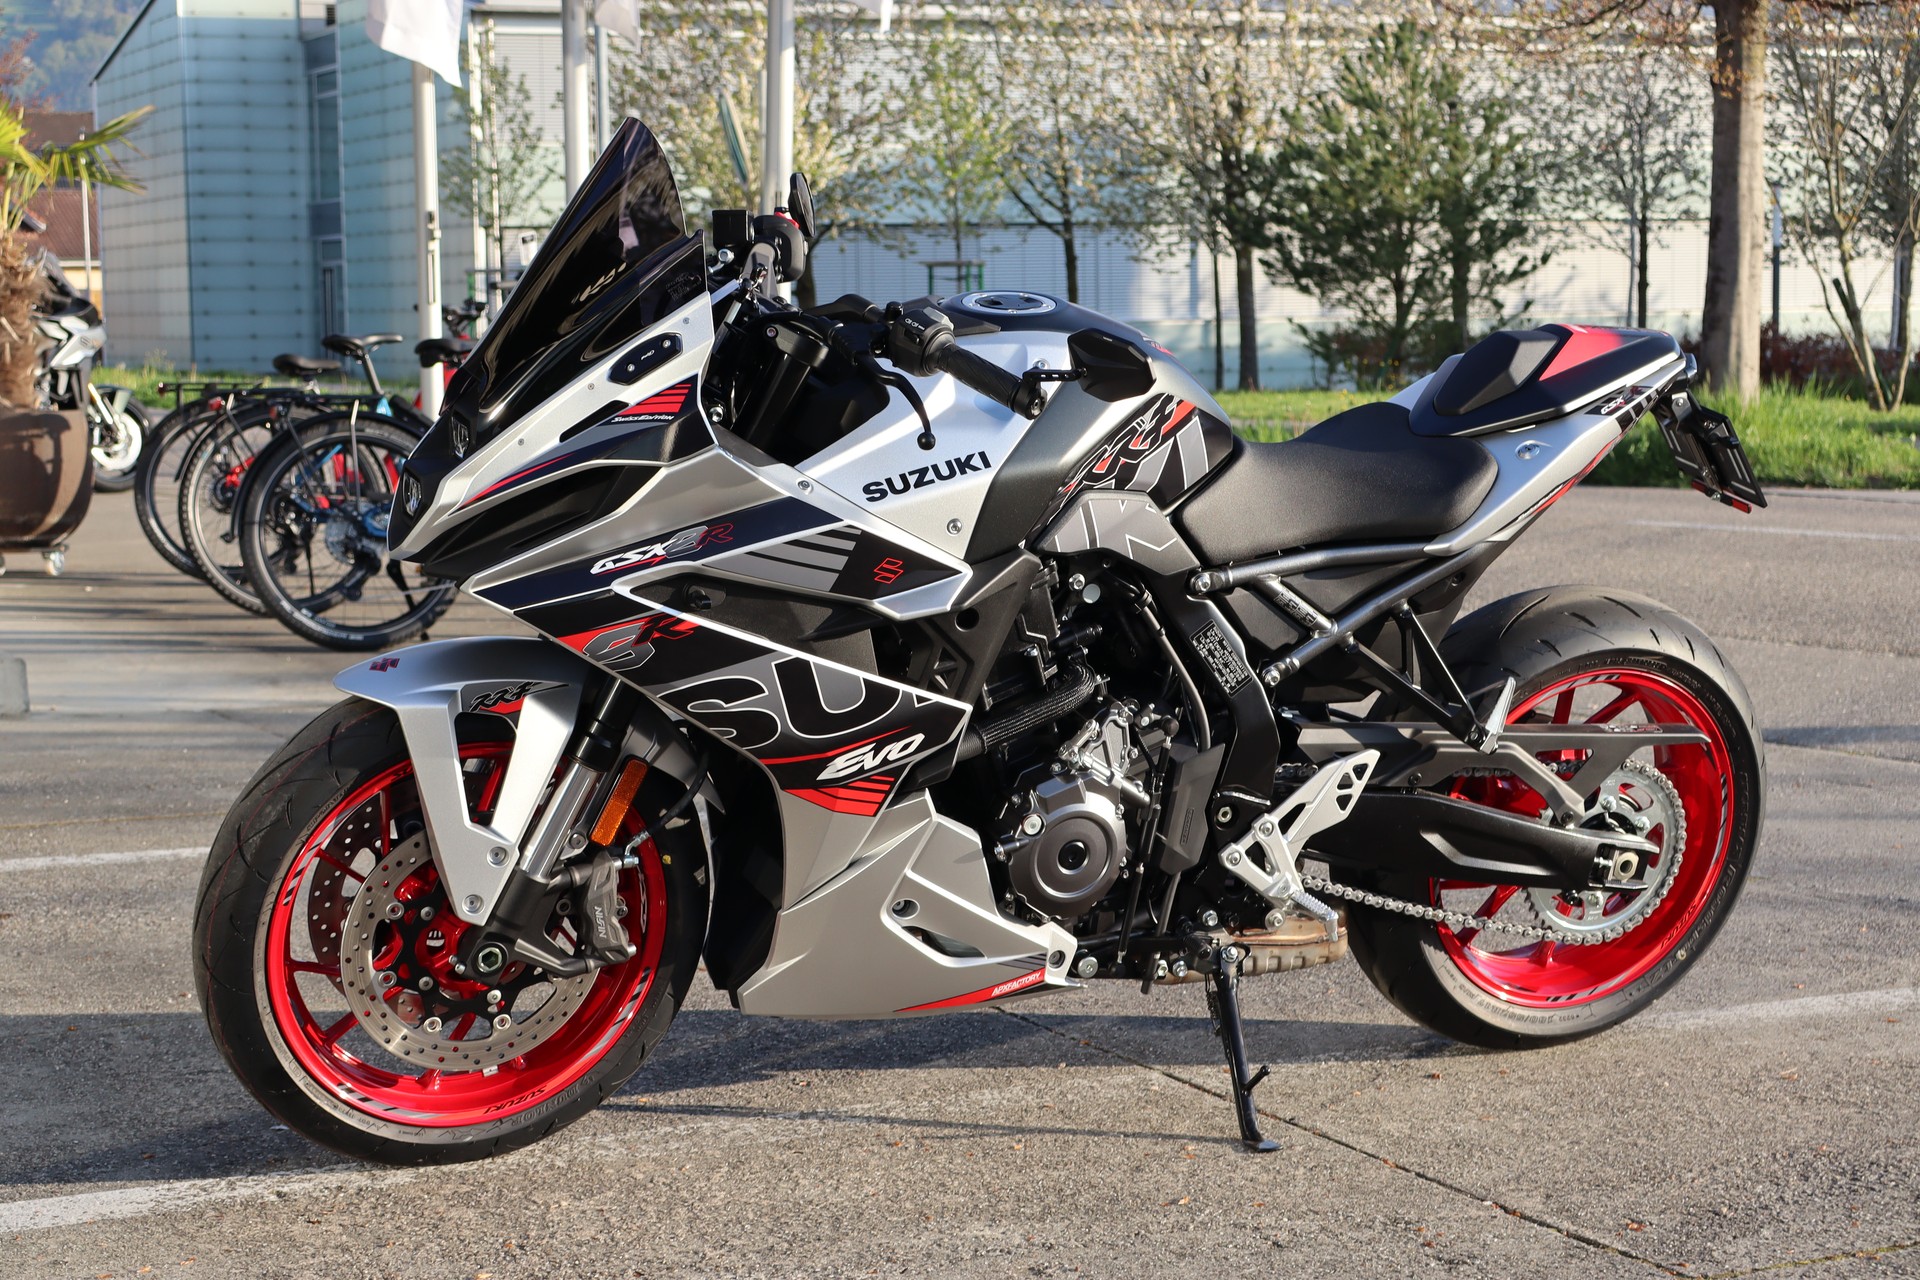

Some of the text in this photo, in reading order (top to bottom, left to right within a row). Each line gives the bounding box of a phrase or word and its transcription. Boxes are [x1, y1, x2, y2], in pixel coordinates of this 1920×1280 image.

[862, 451, 992, 502] SUZUKI
[816, 733, 926, 781] EVO
[594, 905, 607, 938] NISSIN
[483, 1084, 548, 1115] SUZUKI
